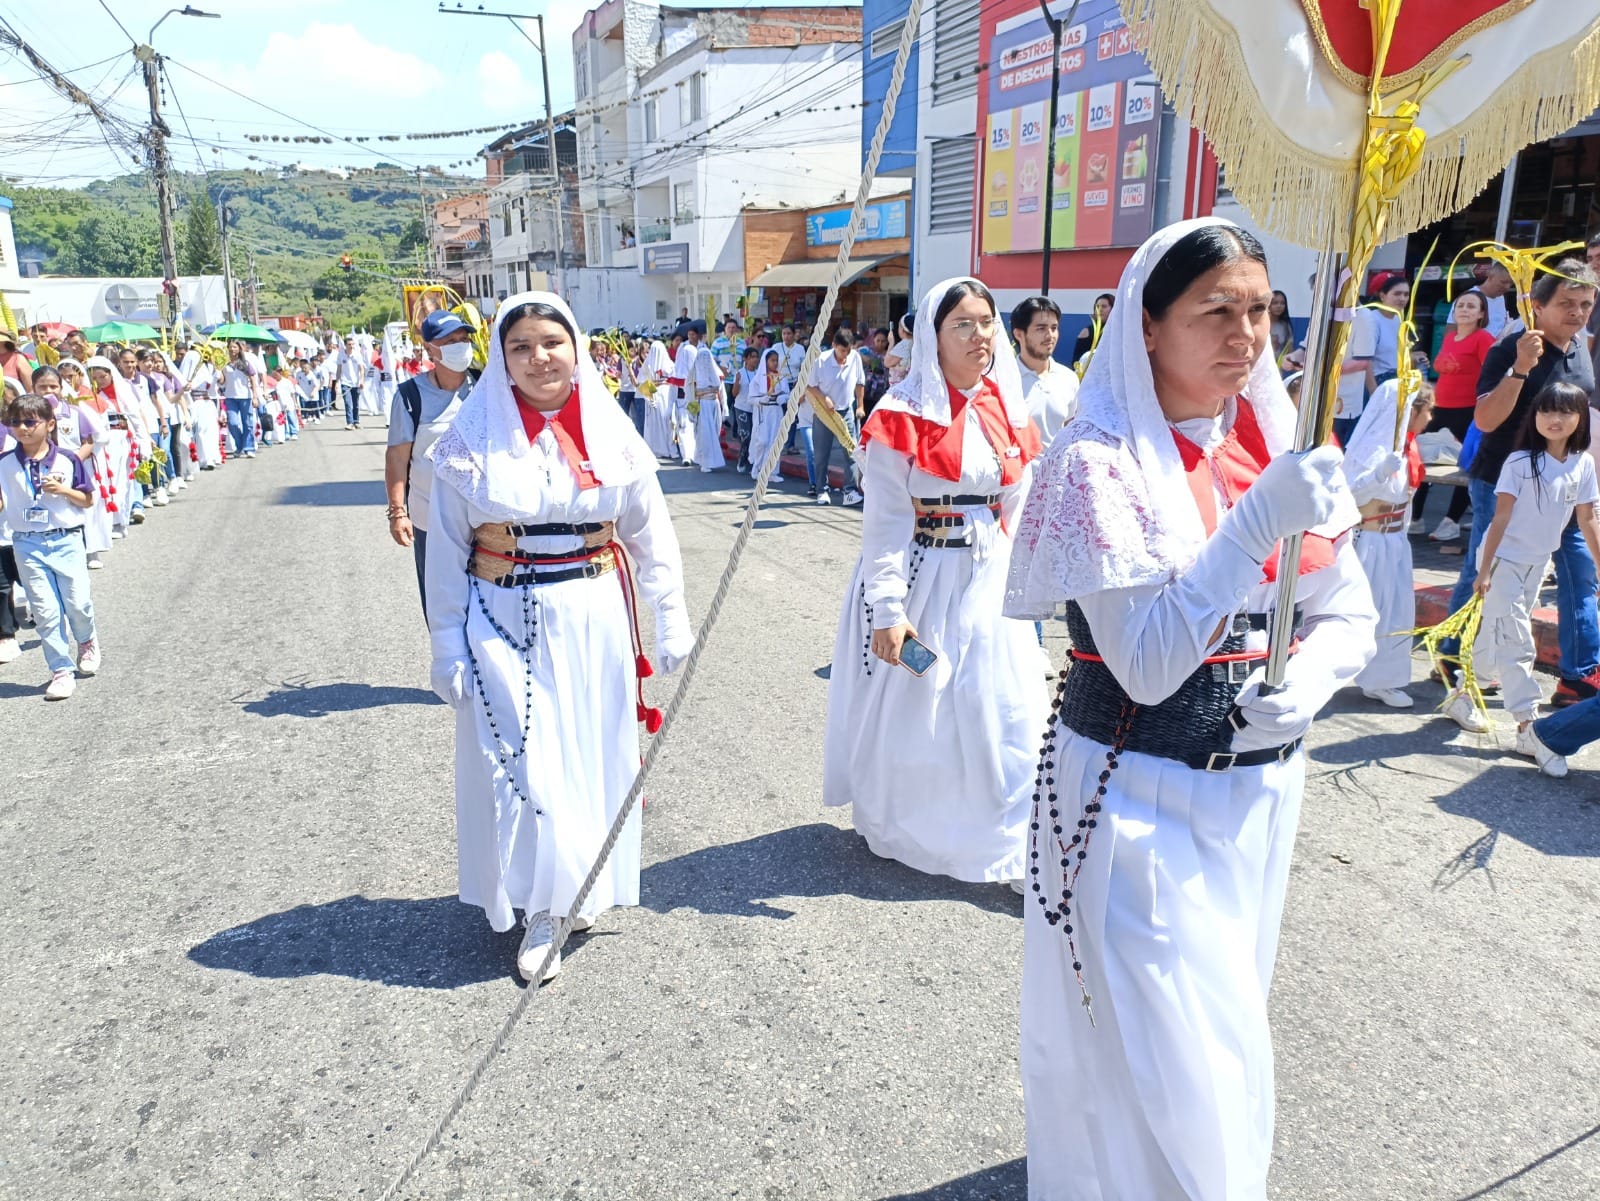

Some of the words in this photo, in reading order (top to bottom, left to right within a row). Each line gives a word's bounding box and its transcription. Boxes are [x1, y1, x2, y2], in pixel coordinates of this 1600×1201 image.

[1001, 73, 1014, 88] DE
[1015, 53, 1082, 84] DESCUETOS
[1128, 96, 1152, 114] 20%
[1090, 105, 1112, 122] 10%
[992, 128, 1010, 143] 15%
[1022, 121, 1041, 137] 20%
[1123, 193, 1143, 205] VINO
